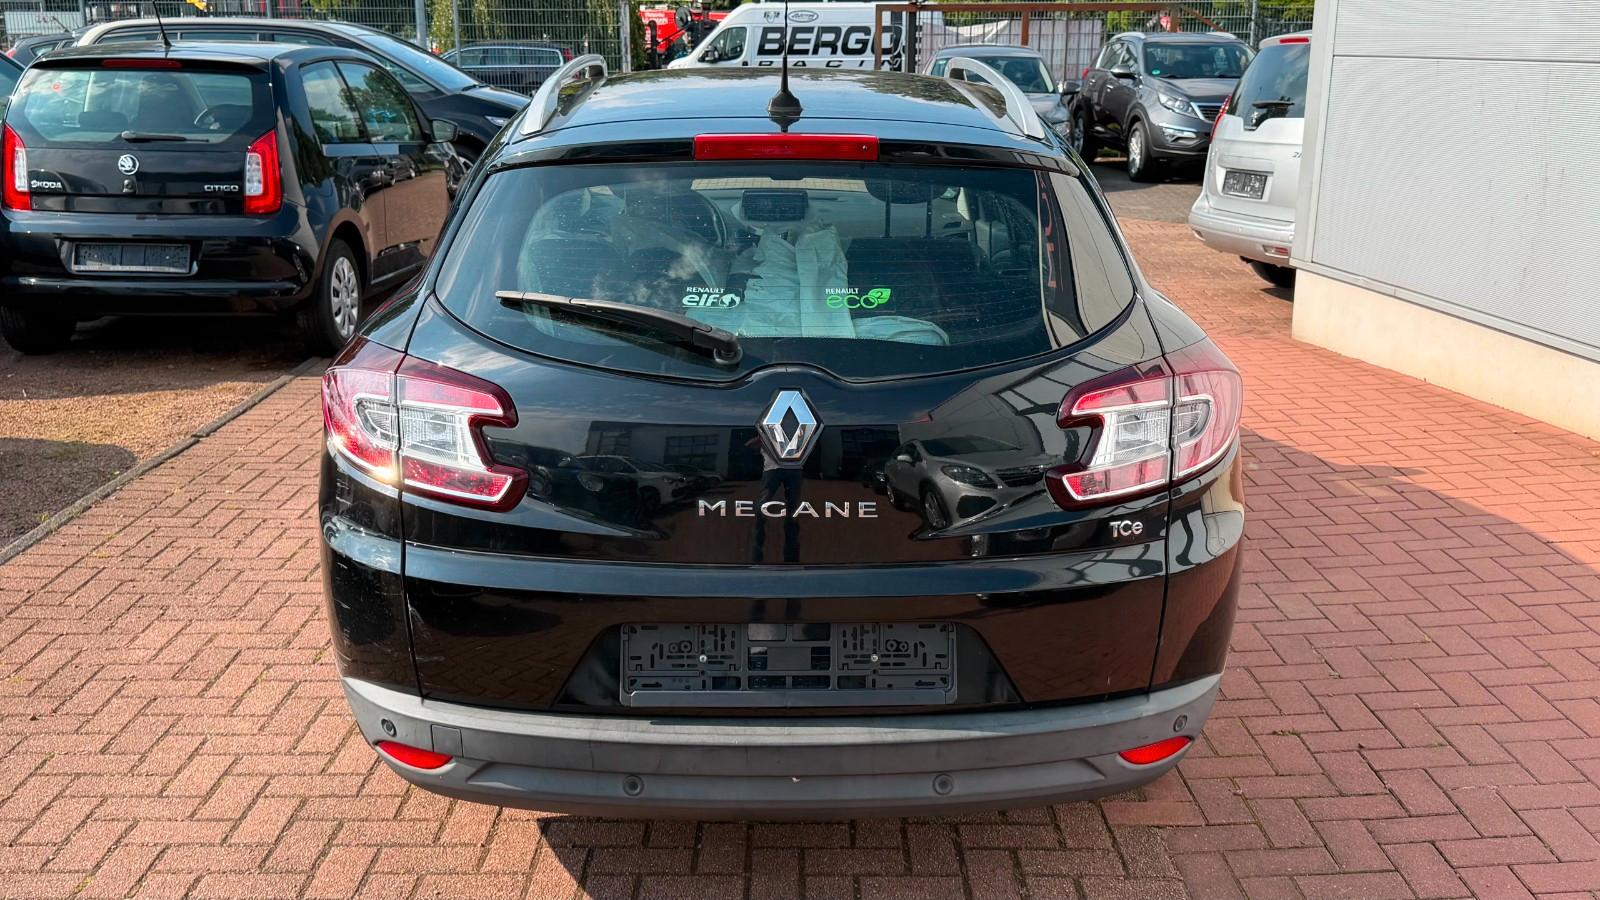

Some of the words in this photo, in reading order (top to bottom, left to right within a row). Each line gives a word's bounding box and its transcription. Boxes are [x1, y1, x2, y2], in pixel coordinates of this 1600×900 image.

[204, 184, 239, 192] CITIGO
[699, 500, 878, 518] MEGANE
[1110, 520, 1143, 538] TCe
